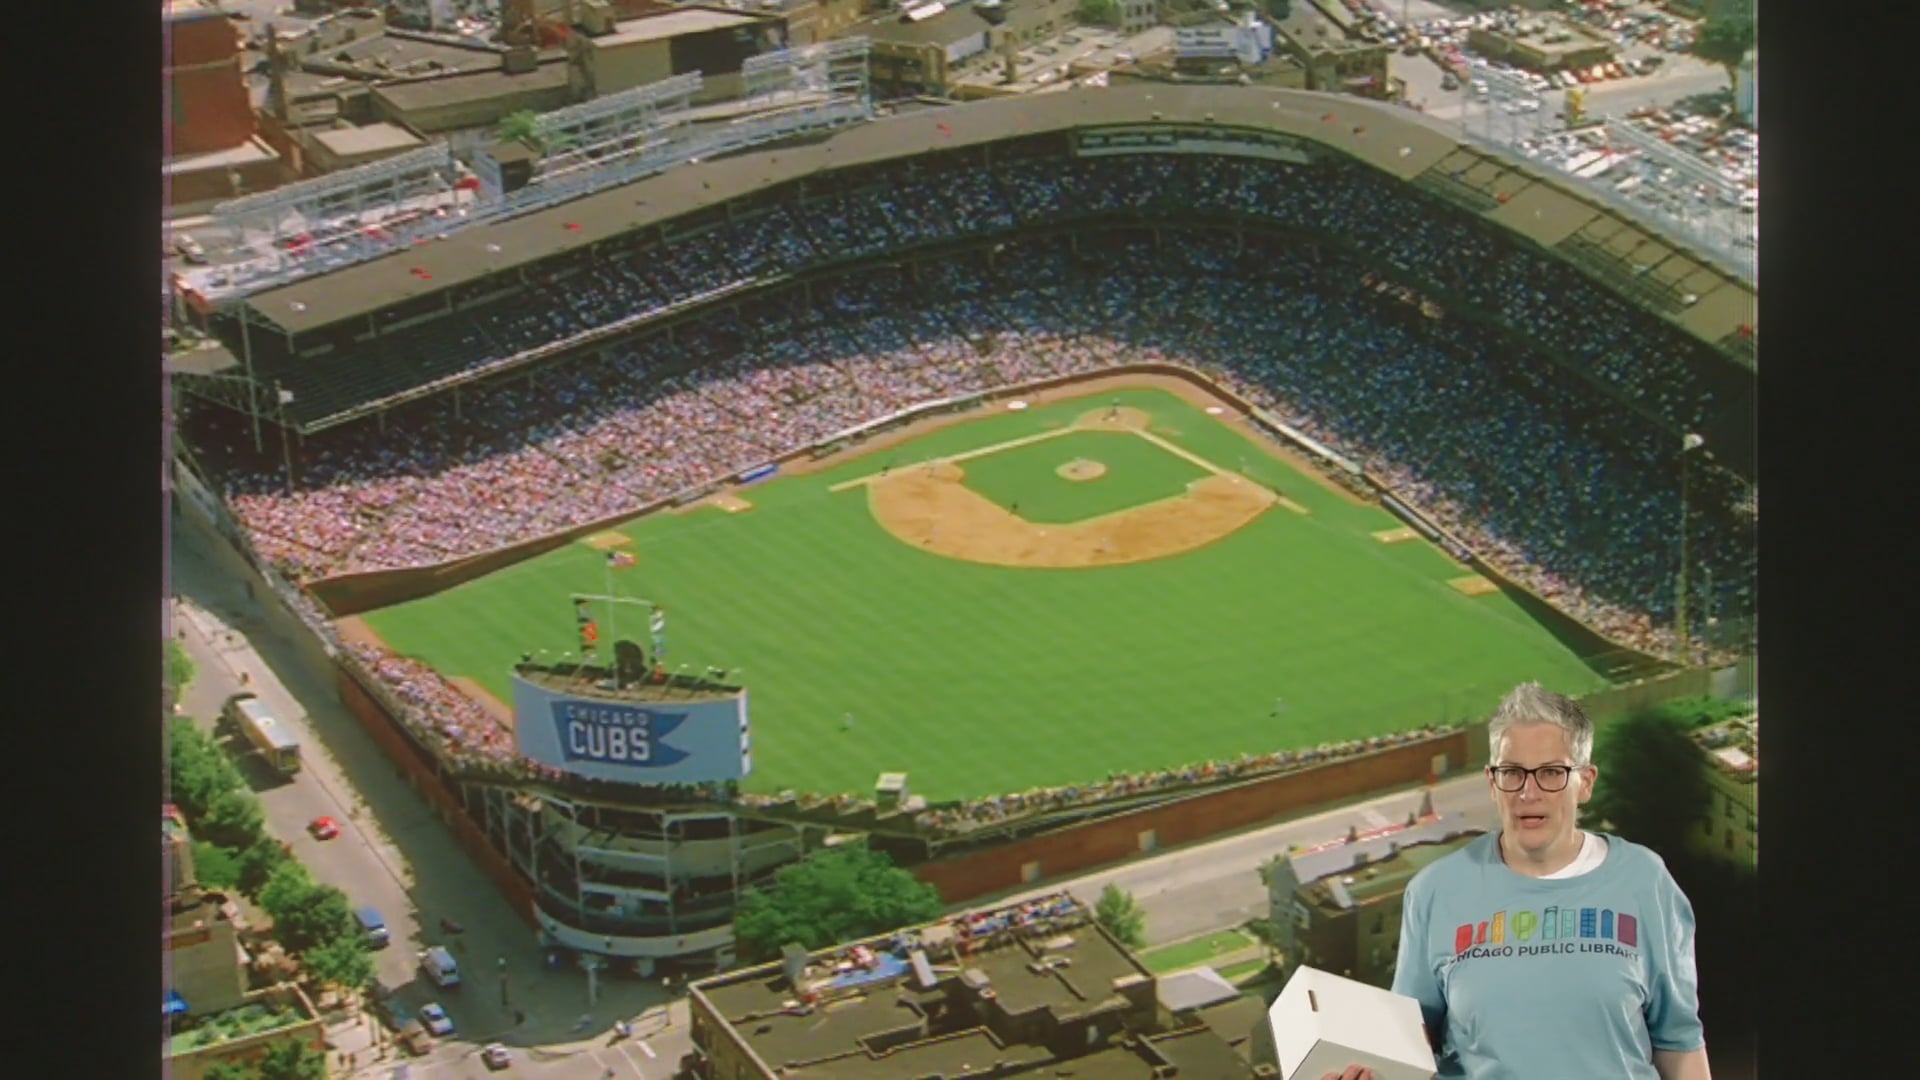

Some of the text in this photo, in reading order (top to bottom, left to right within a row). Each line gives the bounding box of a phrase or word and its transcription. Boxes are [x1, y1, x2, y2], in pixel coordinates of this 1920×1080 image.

[566, 705, 649, 726] CHICAGO
[568, 720, 650, 761] CUBS
[1518, 943, 1575, 956] PUBLIC
